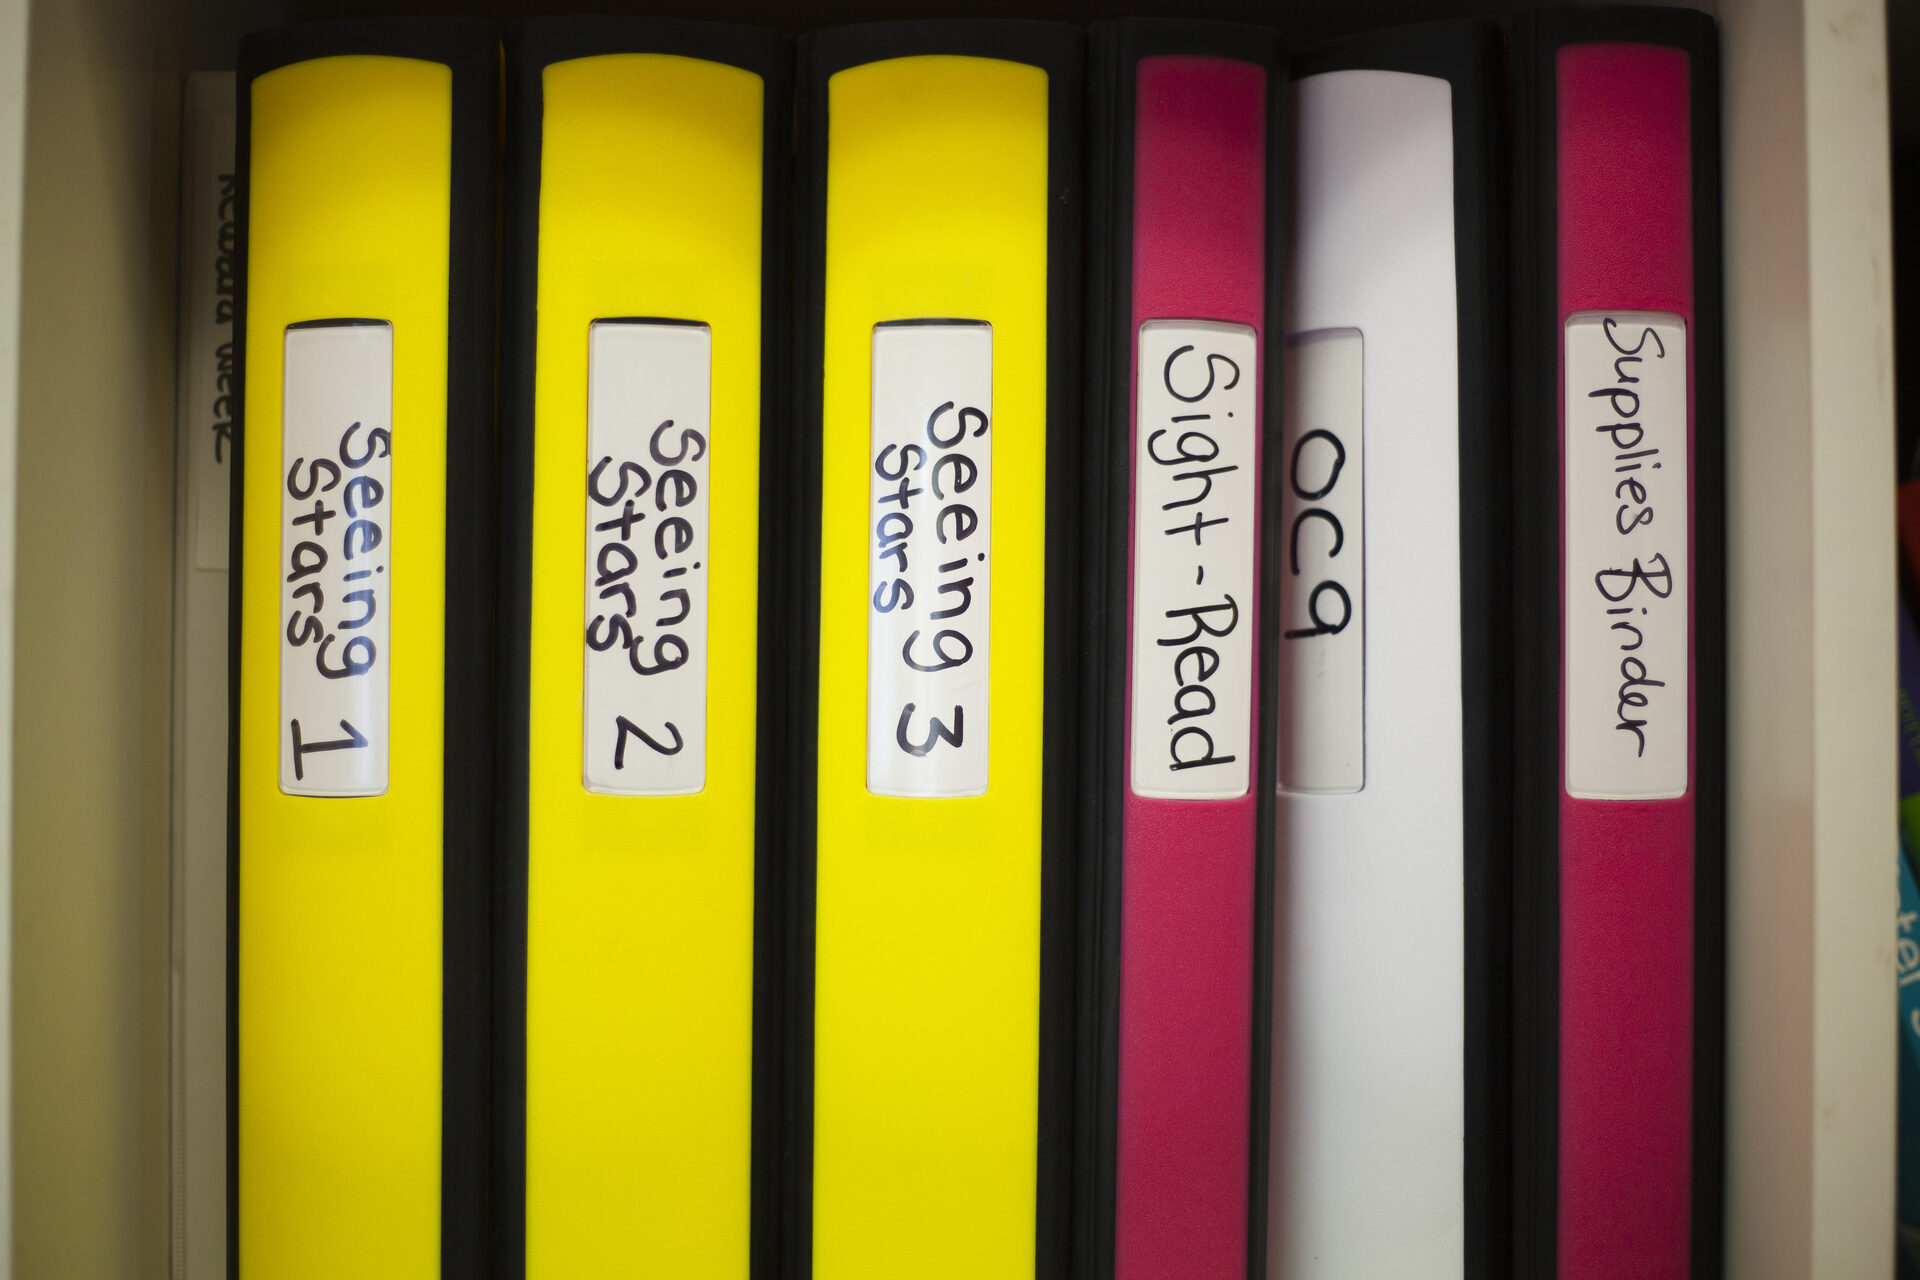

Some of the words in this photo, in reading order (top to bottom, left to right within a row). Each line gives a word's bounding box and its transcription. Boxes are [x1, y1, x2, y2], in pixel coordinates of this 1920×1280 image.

[1587, 317, 1666, 536] Supplies
[286, 456, 341, 648] Stars
[315, 420, 392, 680] Seeing
[587, 455, 653, 652] Stars
[629, 419, 707, 677] Seeing
[873, 443, 927, 614] Stars
[901, 400, 989, 673] Seeing
[290, 717, 369, 782] 1
[613, 714, 685, 771] 2
[895, 702, 965, 758] 3
[1594, 552, 1674, 759] Binder
